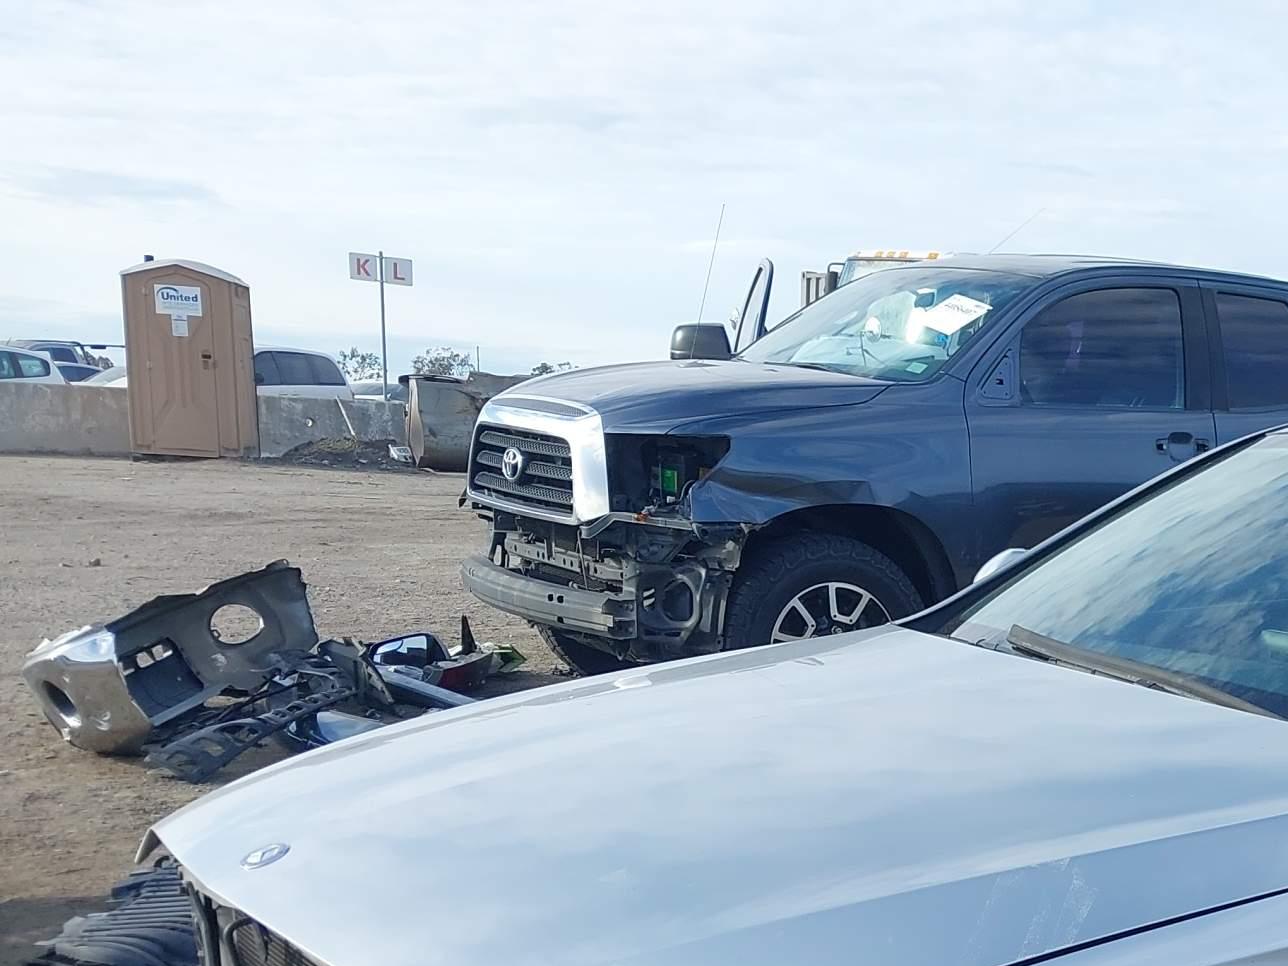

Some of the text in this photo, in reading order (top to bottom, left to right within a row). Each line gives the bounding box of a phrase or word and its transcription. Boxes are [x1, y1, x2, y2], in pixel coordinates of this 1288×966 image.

[356, 257, 371, 277] K
[393, 262, 406, 281] L
[160, 291, 199, 303] United
